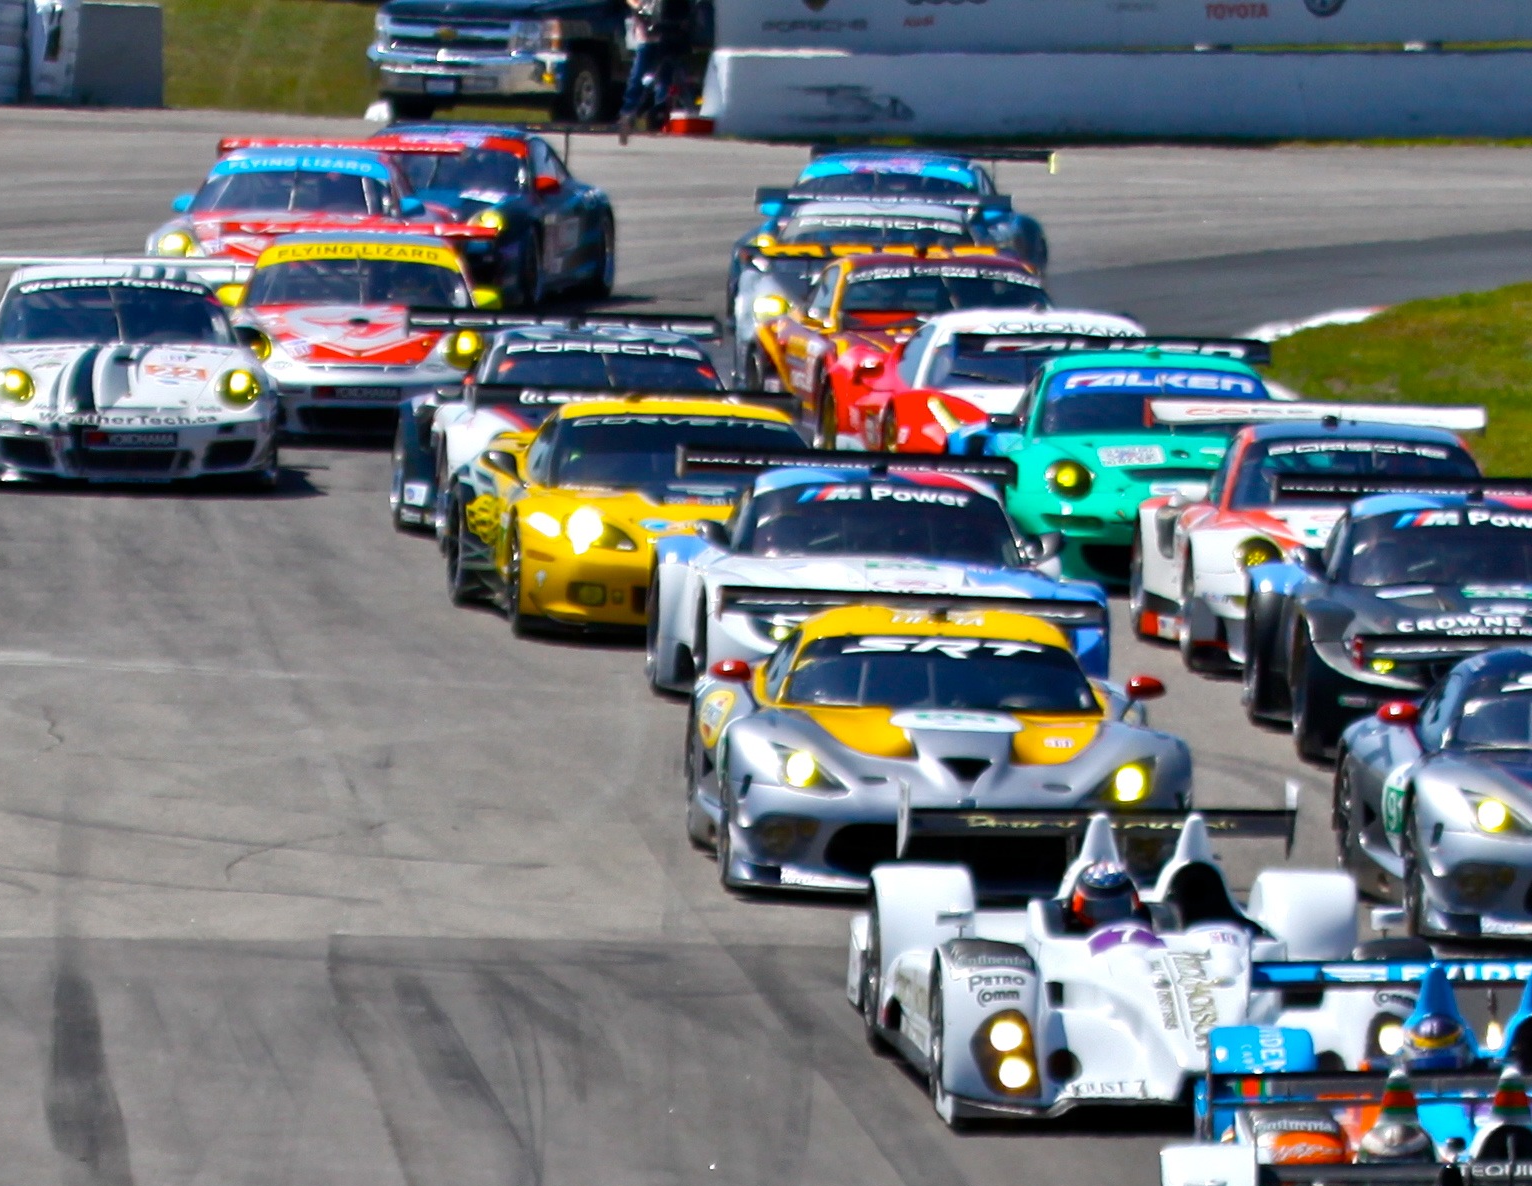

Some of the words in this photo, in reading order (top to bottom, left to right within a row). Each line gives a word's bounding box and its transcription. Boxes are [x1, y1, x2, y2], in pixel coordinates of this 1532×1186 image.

[1205, 3, 1270, 19] TOYOTA
[277, 245, 356, 260] FLYING
[361, 244, 440, 262] LIZARD
[507, 341, 703, 361] PORSCHE
[1065, 368, 1255, 394] FALKEN
[871, 486, 969, 508] Power
[1396, 616, 1523, 633] CROWNE
[841, 636, 1044, 660] SRT
